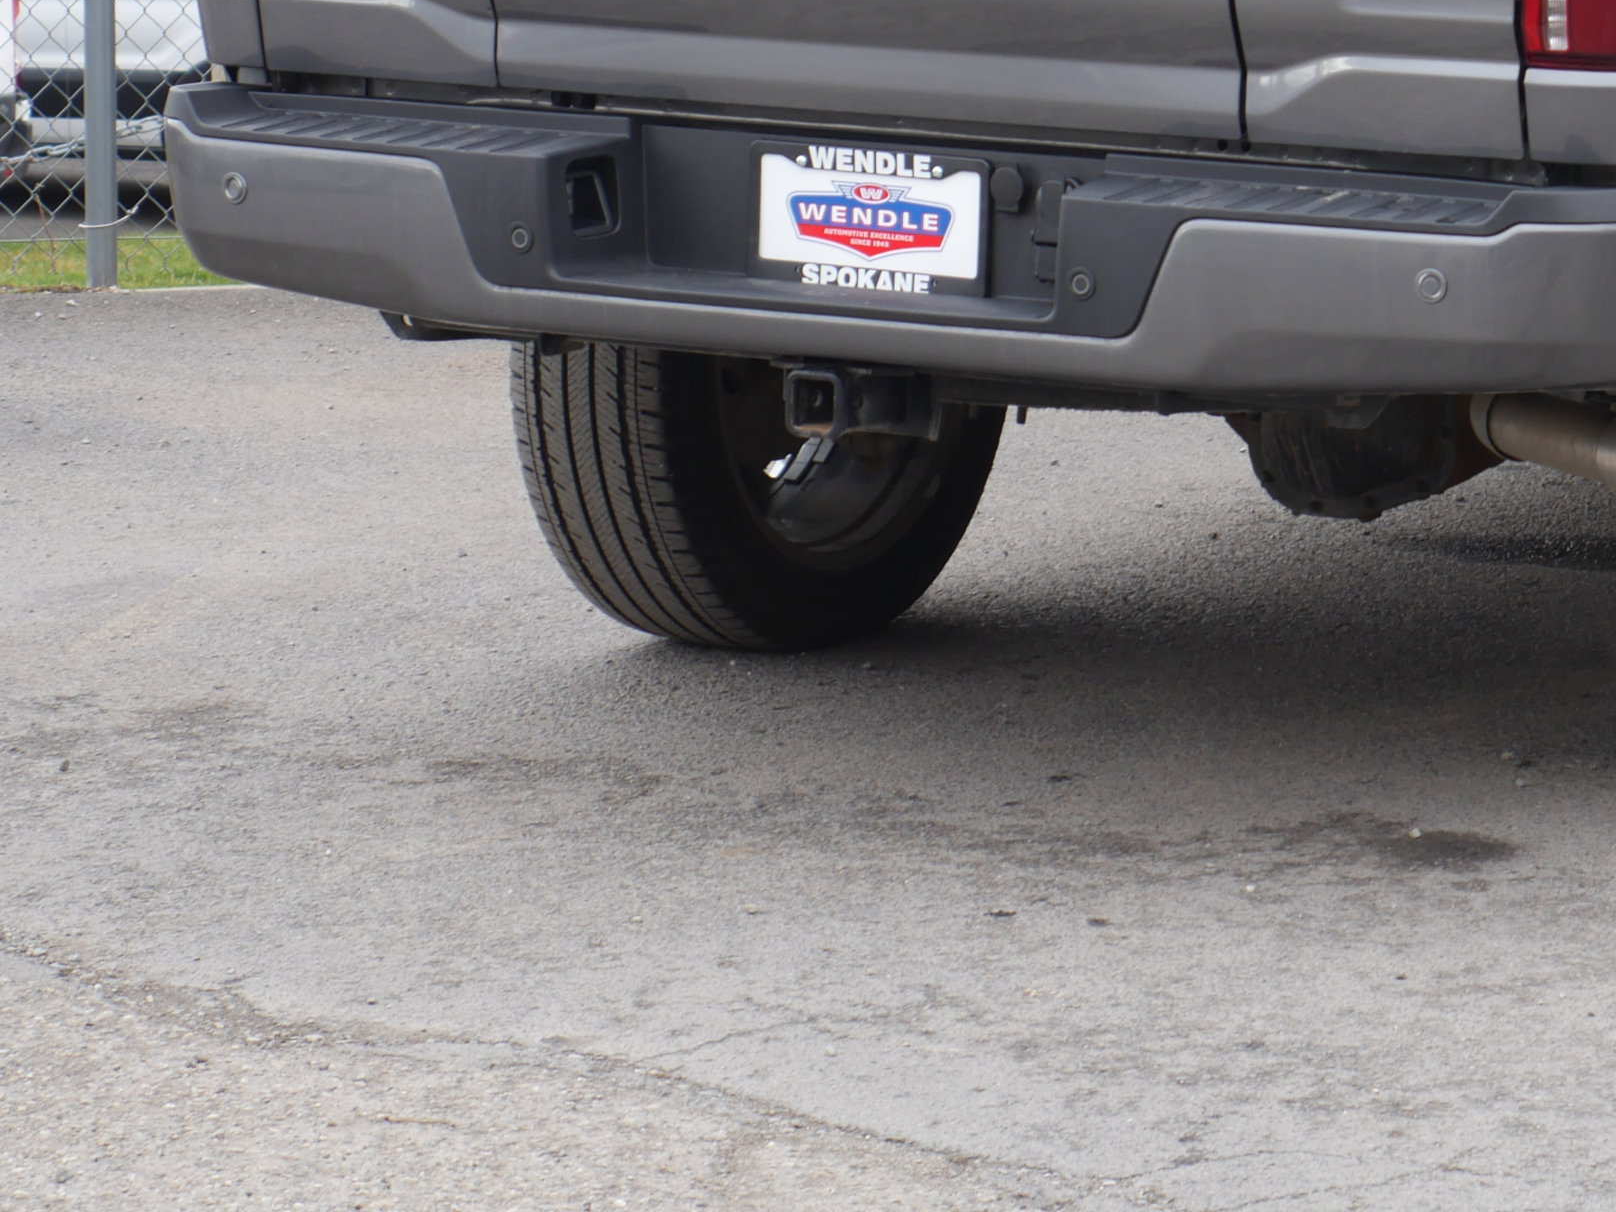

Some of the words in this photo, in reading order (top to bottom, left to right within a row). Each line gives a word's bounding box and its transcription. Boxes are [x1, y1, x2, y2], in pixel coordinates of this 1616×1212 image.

[808, 145, 931, 179] WENDLE
[798, 202, 939, 231] WENDLE
[823, 227, 869, 239] AUTOMOTIVE
[870, 231, 915, 243] EXCELLENCE
[849, 237, 872, 247] SINCE
[801, 263, 930, 295] SPOKANE
